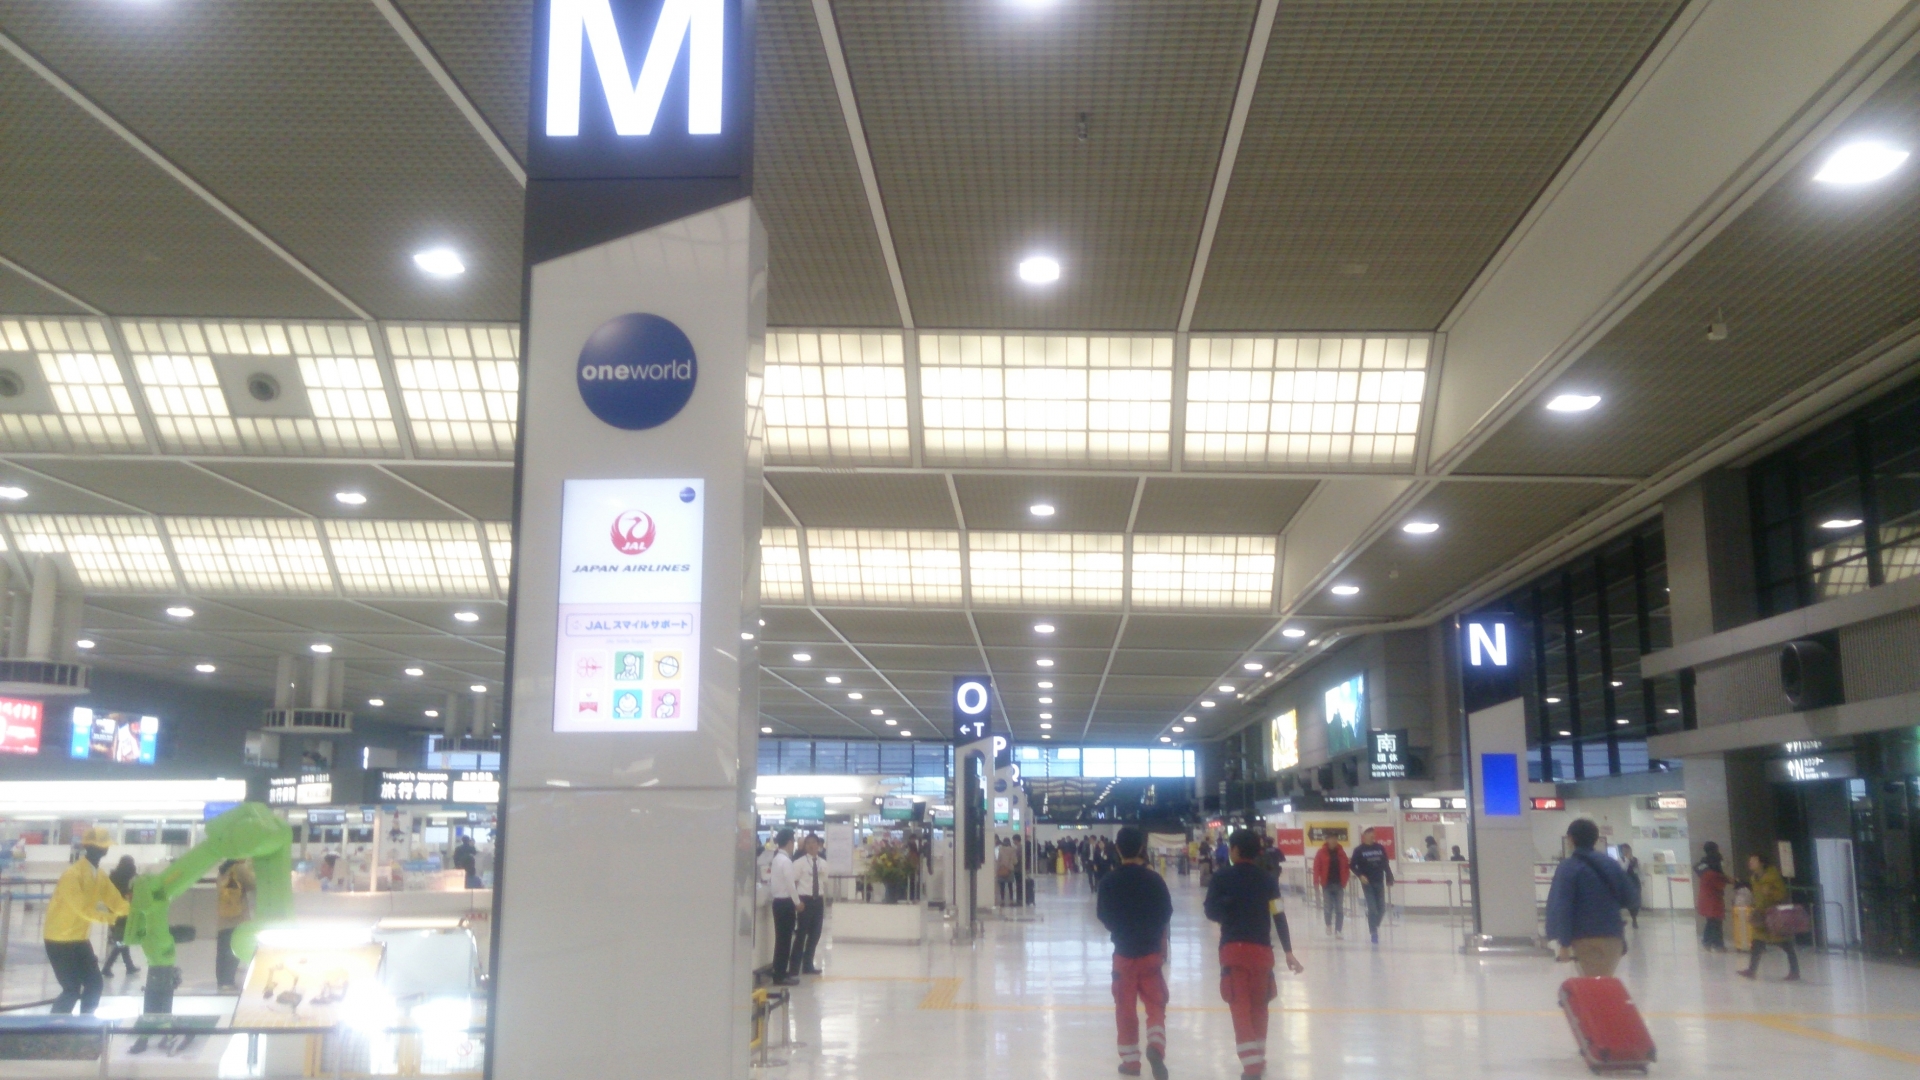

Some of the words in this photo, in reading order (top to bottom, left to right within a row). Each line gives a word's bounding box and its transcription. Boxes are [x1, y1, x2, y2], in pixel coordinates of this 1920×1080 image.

[545, 0, 724, 136] M
[581, 359, 692, 381] oneworld
[621, 541, 647, 551] JAL
[572, 564, 619, 573] JAPAN
[622, 563, 691, 572] AIRLINES
[1469, 623, 1507, 666] N
[957, 681, 988, 714] O
[973, 722, 985, 737] T
[993, 736, 1007, 757] P
[1376, 733, 1397, 753] 南
[1794, 759, 1805, 780] N
